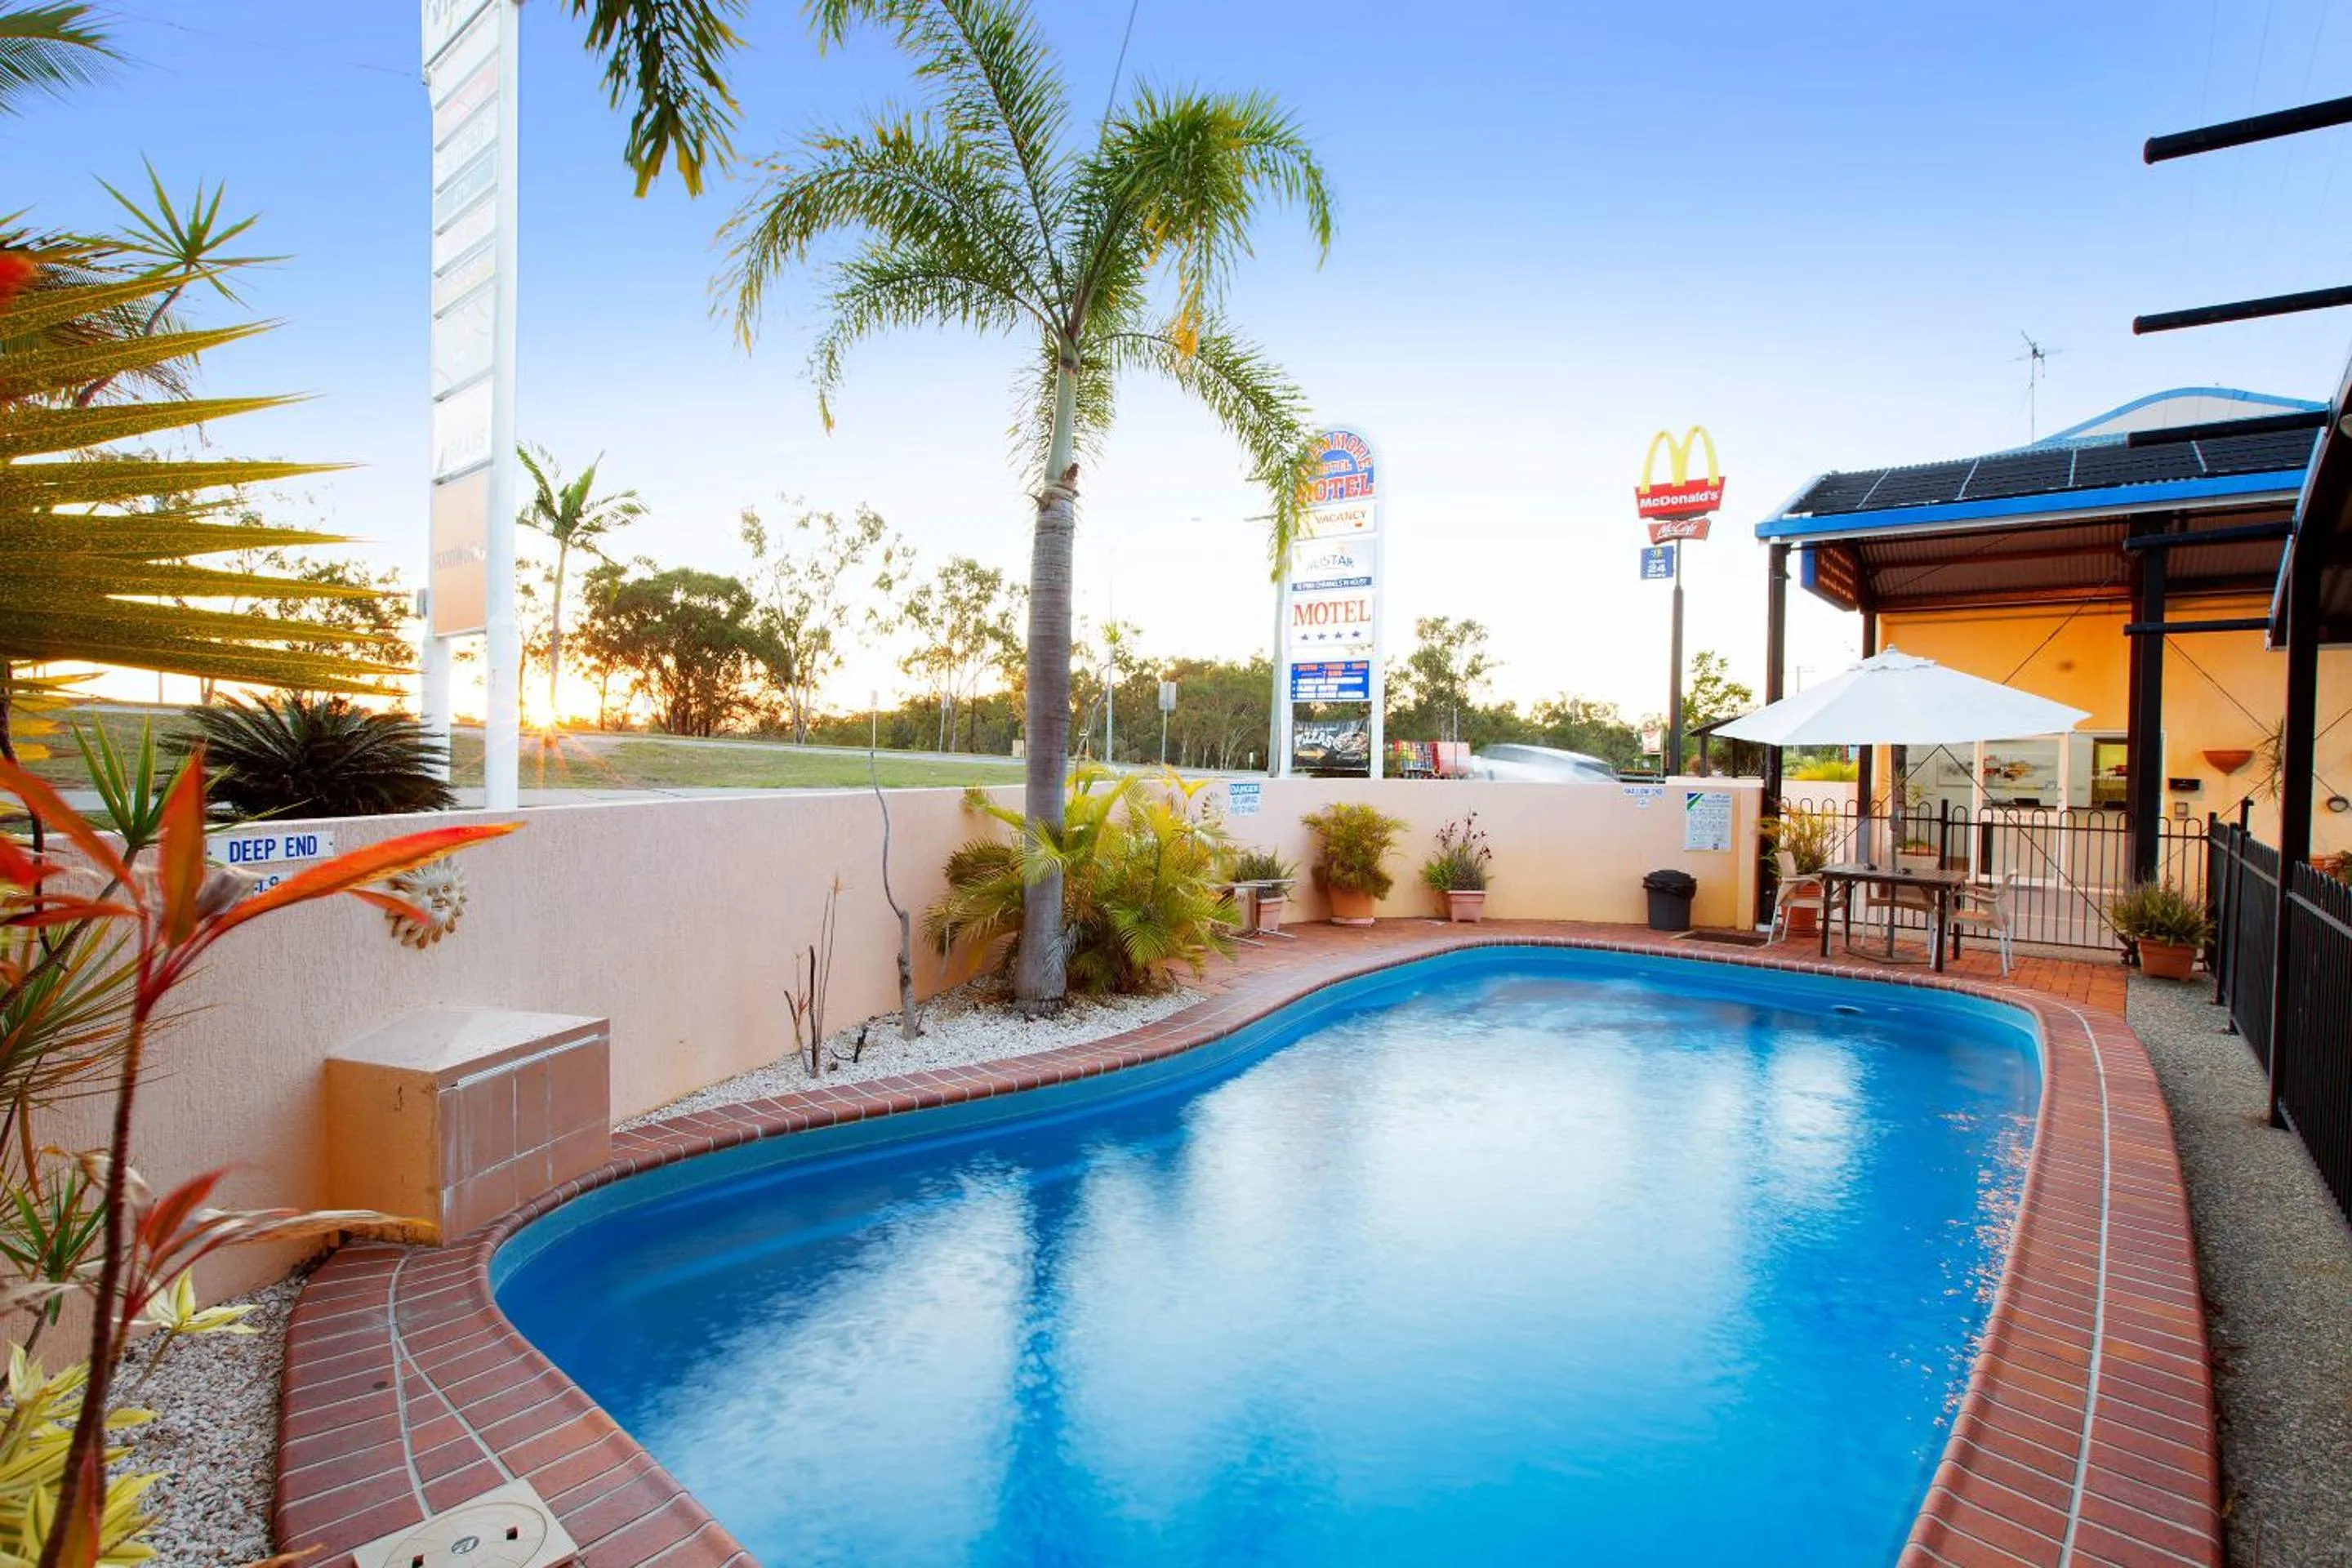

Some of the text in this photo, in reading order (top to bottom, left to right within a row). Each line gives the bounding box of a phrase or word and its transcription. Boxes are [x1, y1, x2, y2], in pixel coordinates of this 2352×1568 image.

[1639, 490, 1719, 509] McDonald's
[1315, 509, 1367, 524] VACANCY
[1293, 600, 1371, 626] MOTEL
[229, 835, 318, 863] DEEP END
